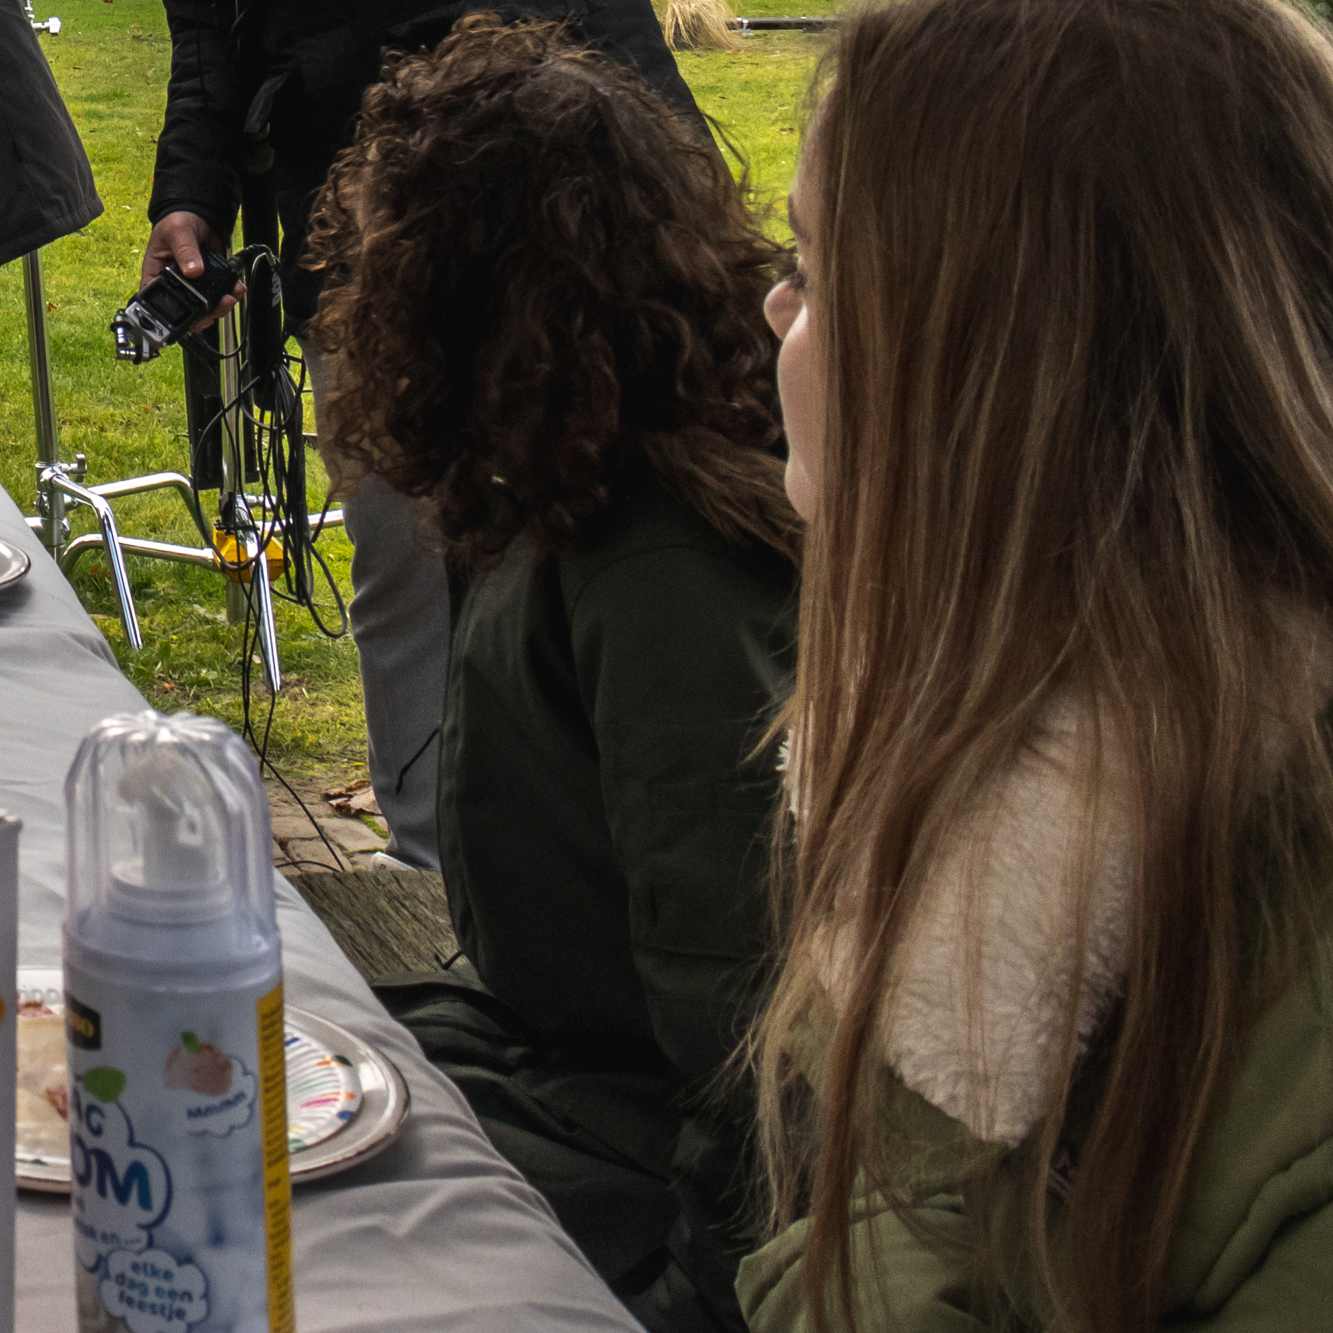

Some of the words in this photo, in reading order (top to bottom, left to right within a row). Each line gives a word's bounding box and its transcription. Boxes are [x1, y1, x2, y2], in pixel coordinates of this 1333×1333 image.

[115, 1272, 150, 1297] dag
[155, 1286, 194, 1303] een
[131, 1262, 174, 1283] elke
[118, 1290, 186, 1322] feestje
